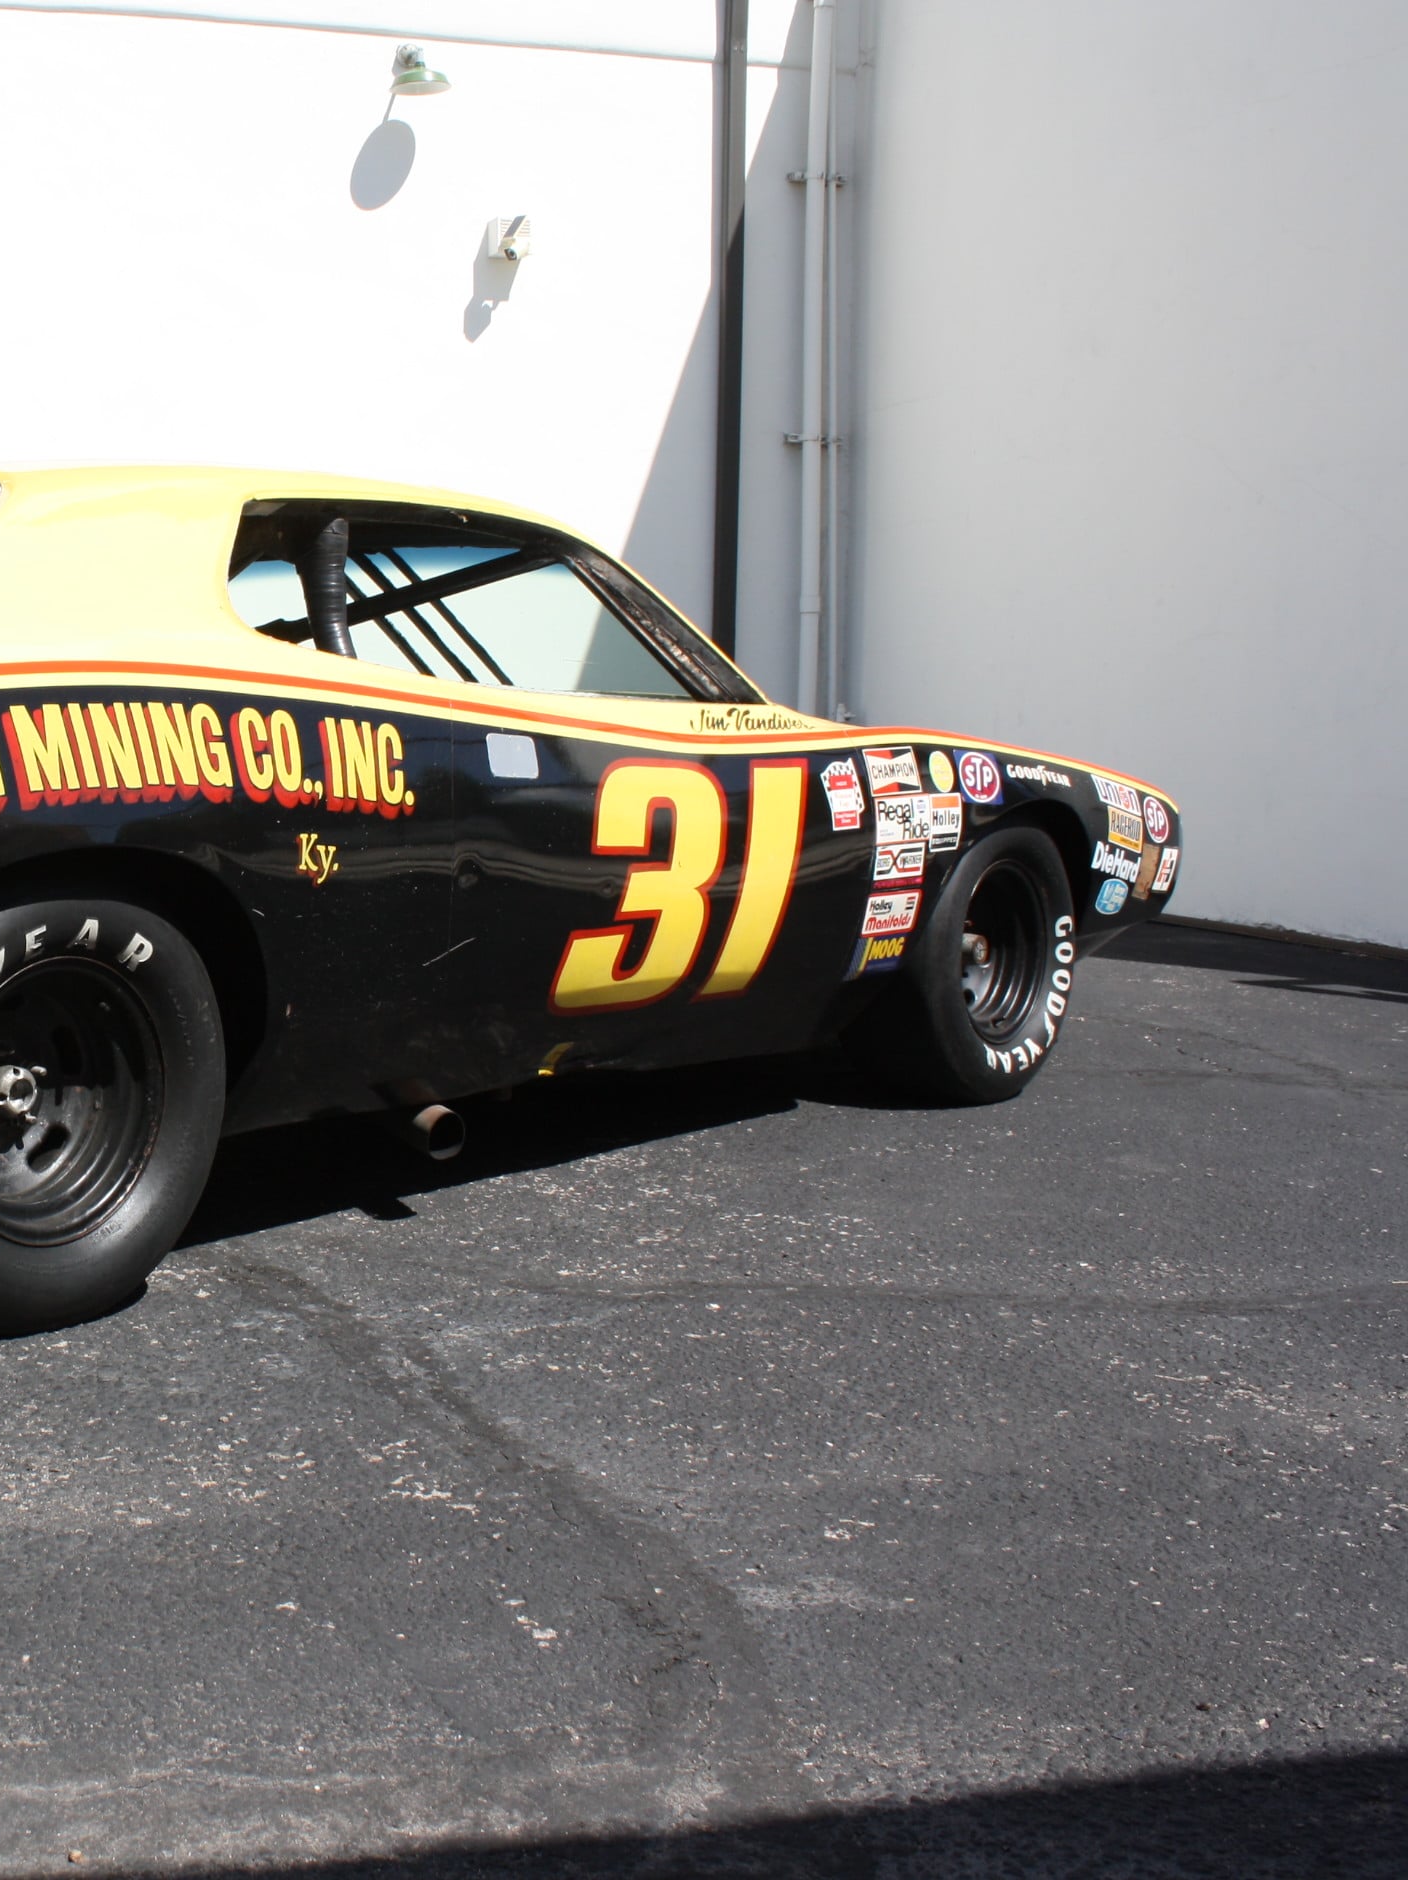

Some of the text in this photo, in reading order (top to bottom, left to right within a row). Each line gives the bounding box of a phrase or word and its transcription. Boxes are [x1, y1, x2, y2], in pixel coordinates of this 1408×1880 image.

[690, 709, 729, 733] Jim
[6, 702, 234, 797] MINING
[324, 717, 415, 808] INC.
[871, 762, 915, 779] CHAMPION
[964, 757, 993, 791] STP
[1006, 764, 1072, 788] GOODYEAR
[877, 799, 915, 825] Regal
[933, 810, 960, 828] Holley
[1146, 801, 1165, 832] STP
[902, 817, 930, 840] Ride
[298, 832, 339, 884] Ky.
[1091, 841, 1142, 884] DieHard
[549, 757, 808, 1016] 31
[869, 899, 893, 913] Holley
[865, 912, 912, 931] Manifolds
[869, 937, 906, 961] MOOG
